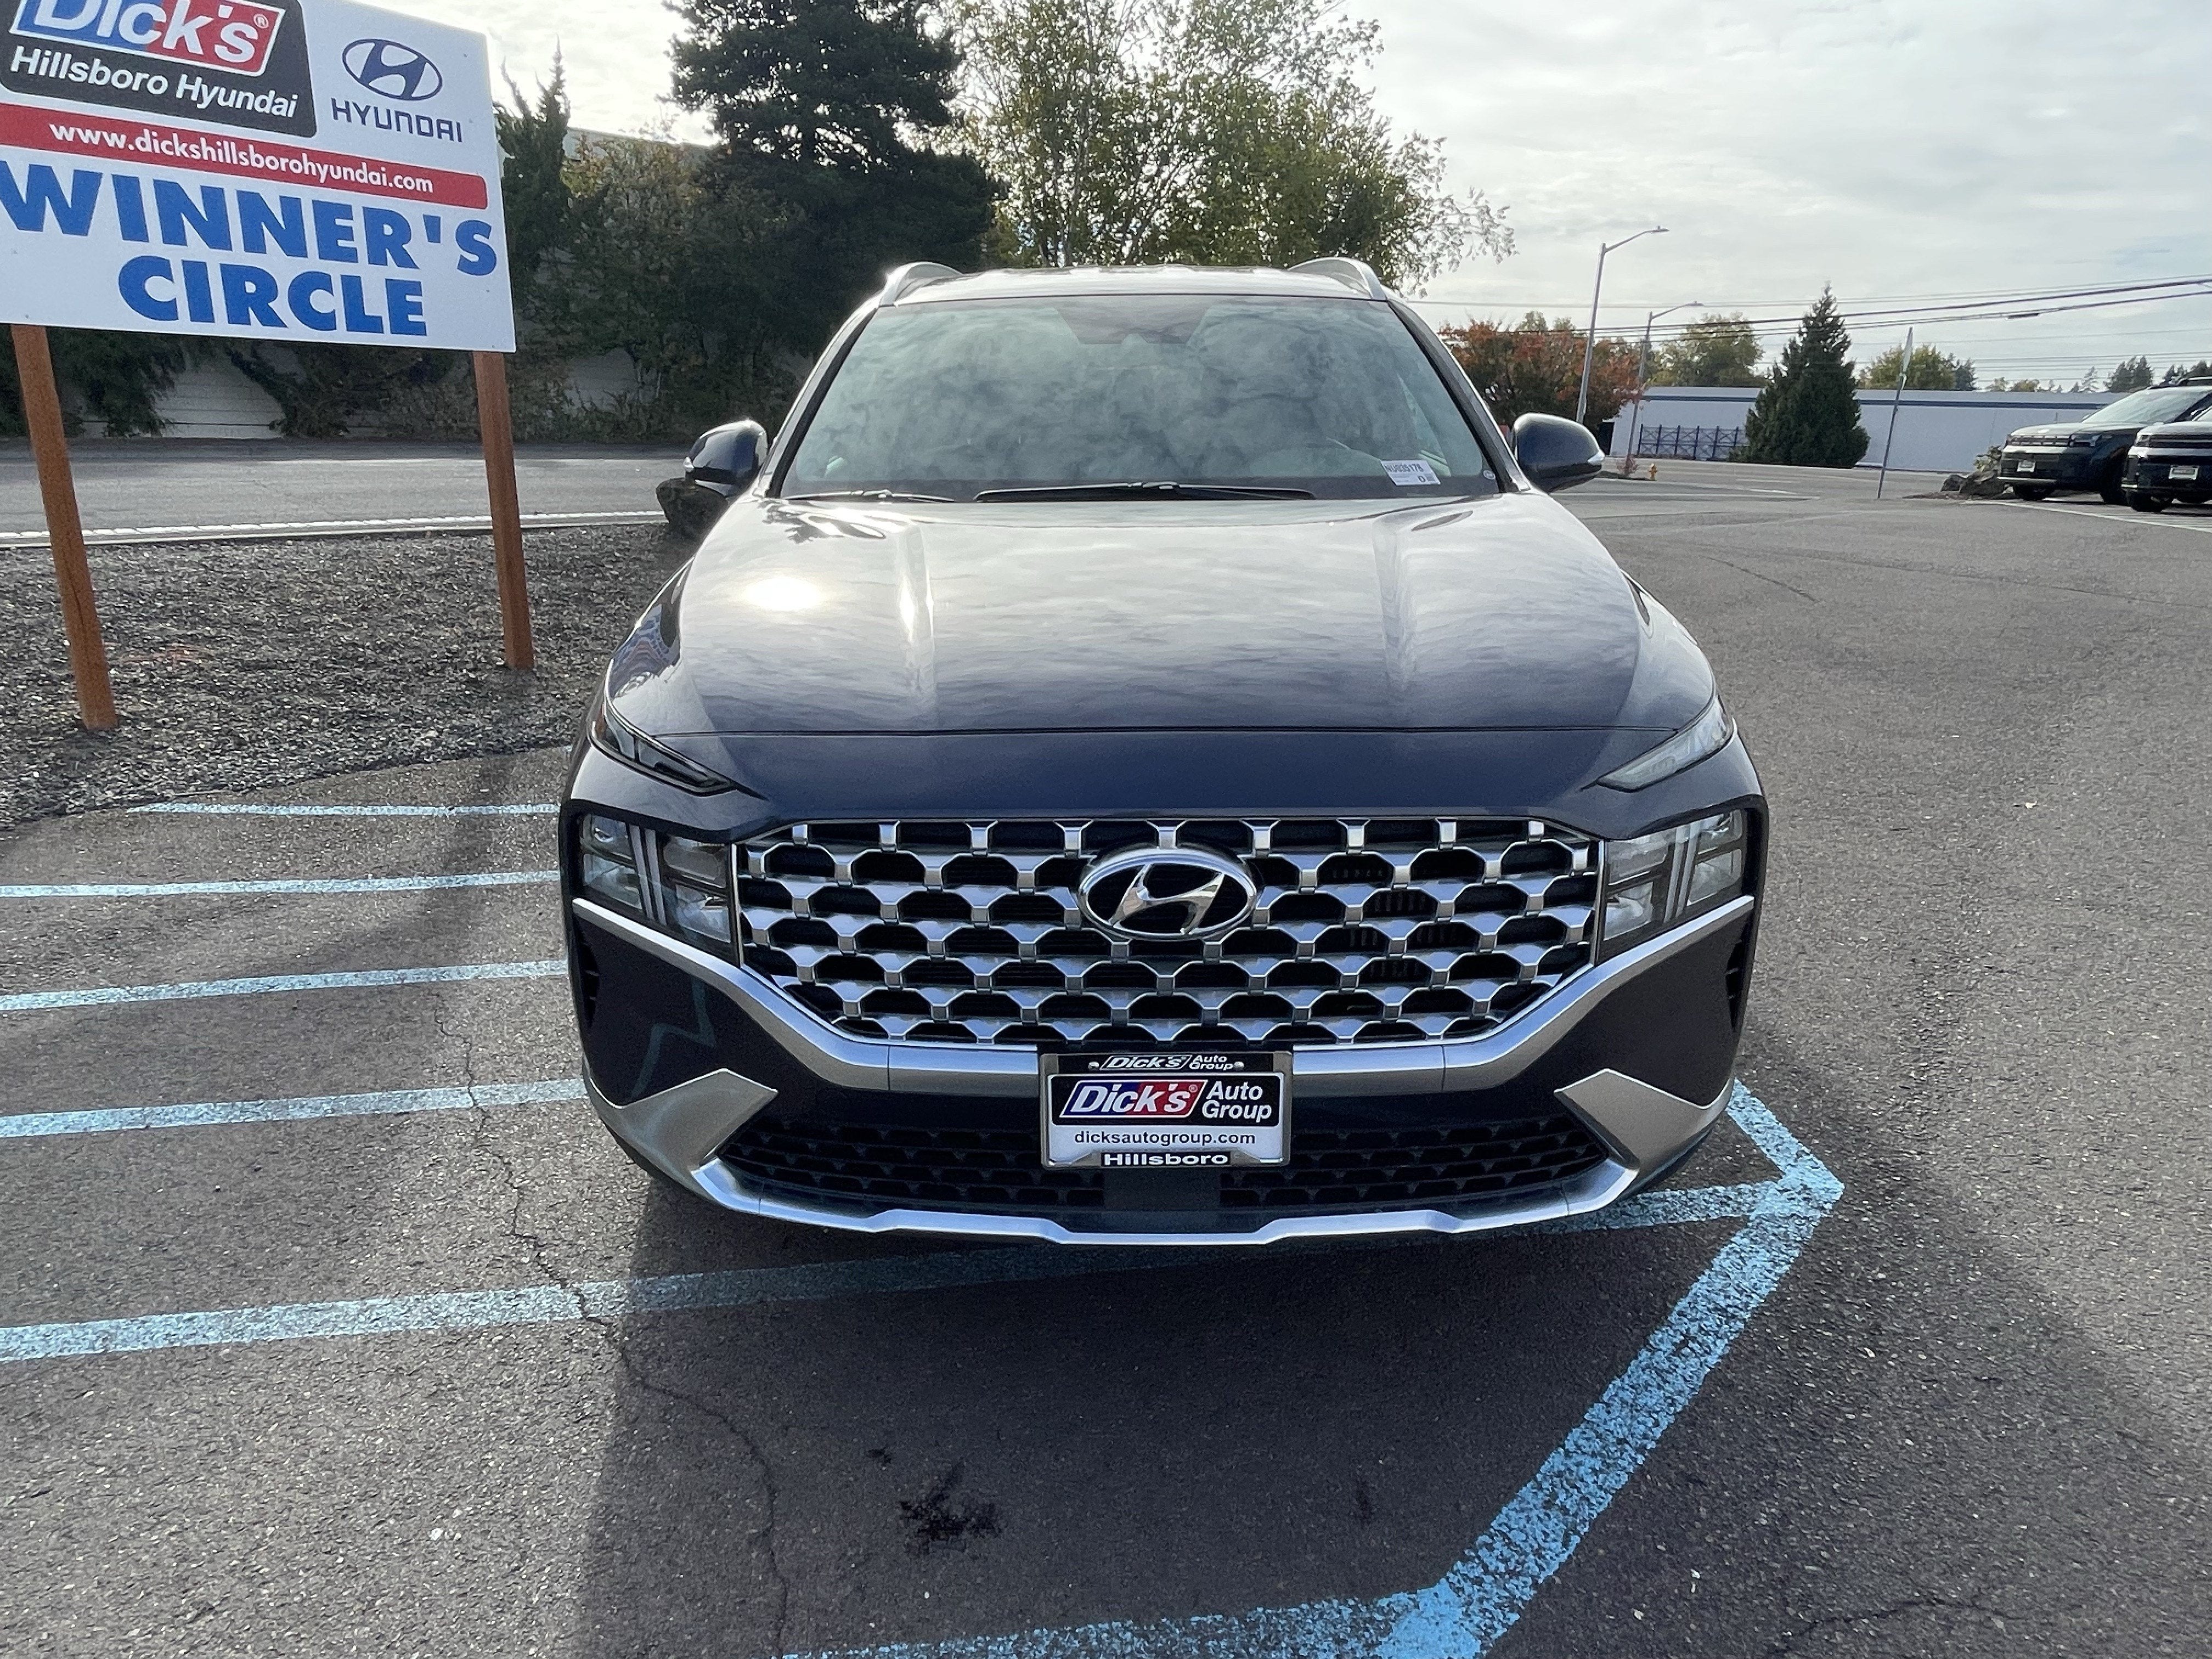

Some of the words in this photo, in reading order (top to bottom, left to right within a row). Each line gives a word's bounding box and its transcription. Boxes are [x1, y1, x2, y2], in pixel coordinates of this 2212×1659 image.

[10, 46, 168, 95] Hillsboro
[176, 74, 298, 118] Hyundai
[331, 98, 463, 143] HYUNDAI
[48, 123, 434, 194] www.dickshillsborohyundai.com
[0, 160, 498, 277] WINNER'S
[118, 255, 427, 337] CIRCLE
[1106, 1056, 1182, 1068] Dick's
[1188, 1062, 1233, 1071] Group
[1070, 1083, 1192, 1113] Dick's
[1206, 1081, 1263, 1101] Auto
[1201, 1101, 1272, 1123] Group
[1074, 1130, 1256, 1147] dicksautogroup.com
[1104, 1153, 1228, 1166] Hillsboro
